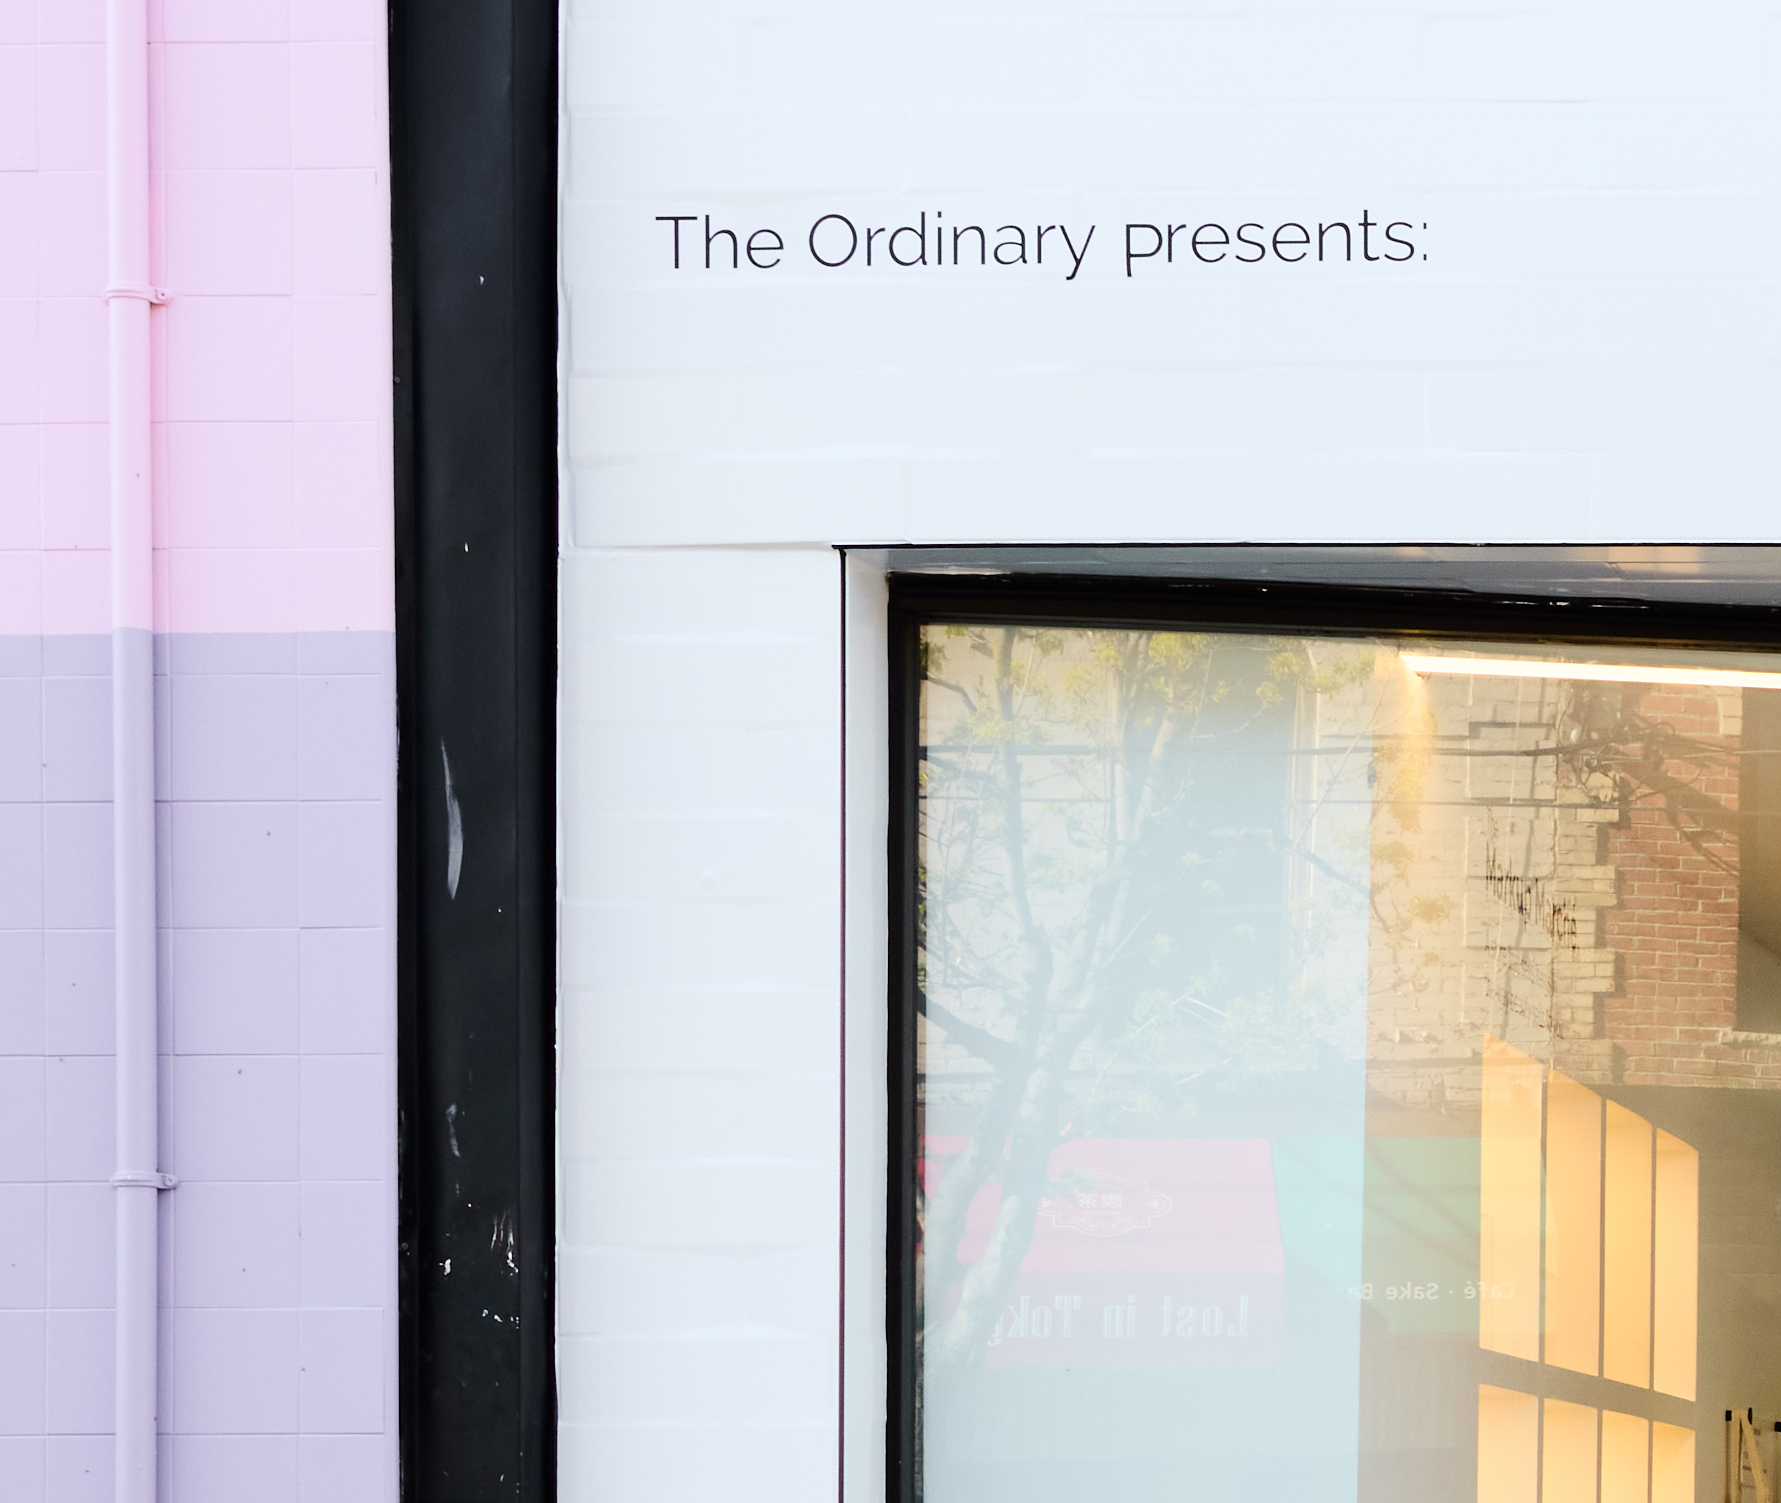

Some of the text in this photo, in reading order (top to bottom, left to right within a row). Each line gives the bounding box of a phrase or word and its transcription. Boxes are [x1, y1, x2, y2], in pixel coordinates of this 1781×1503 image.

[655, 209, 1427, 281] The Ordinary presents:
